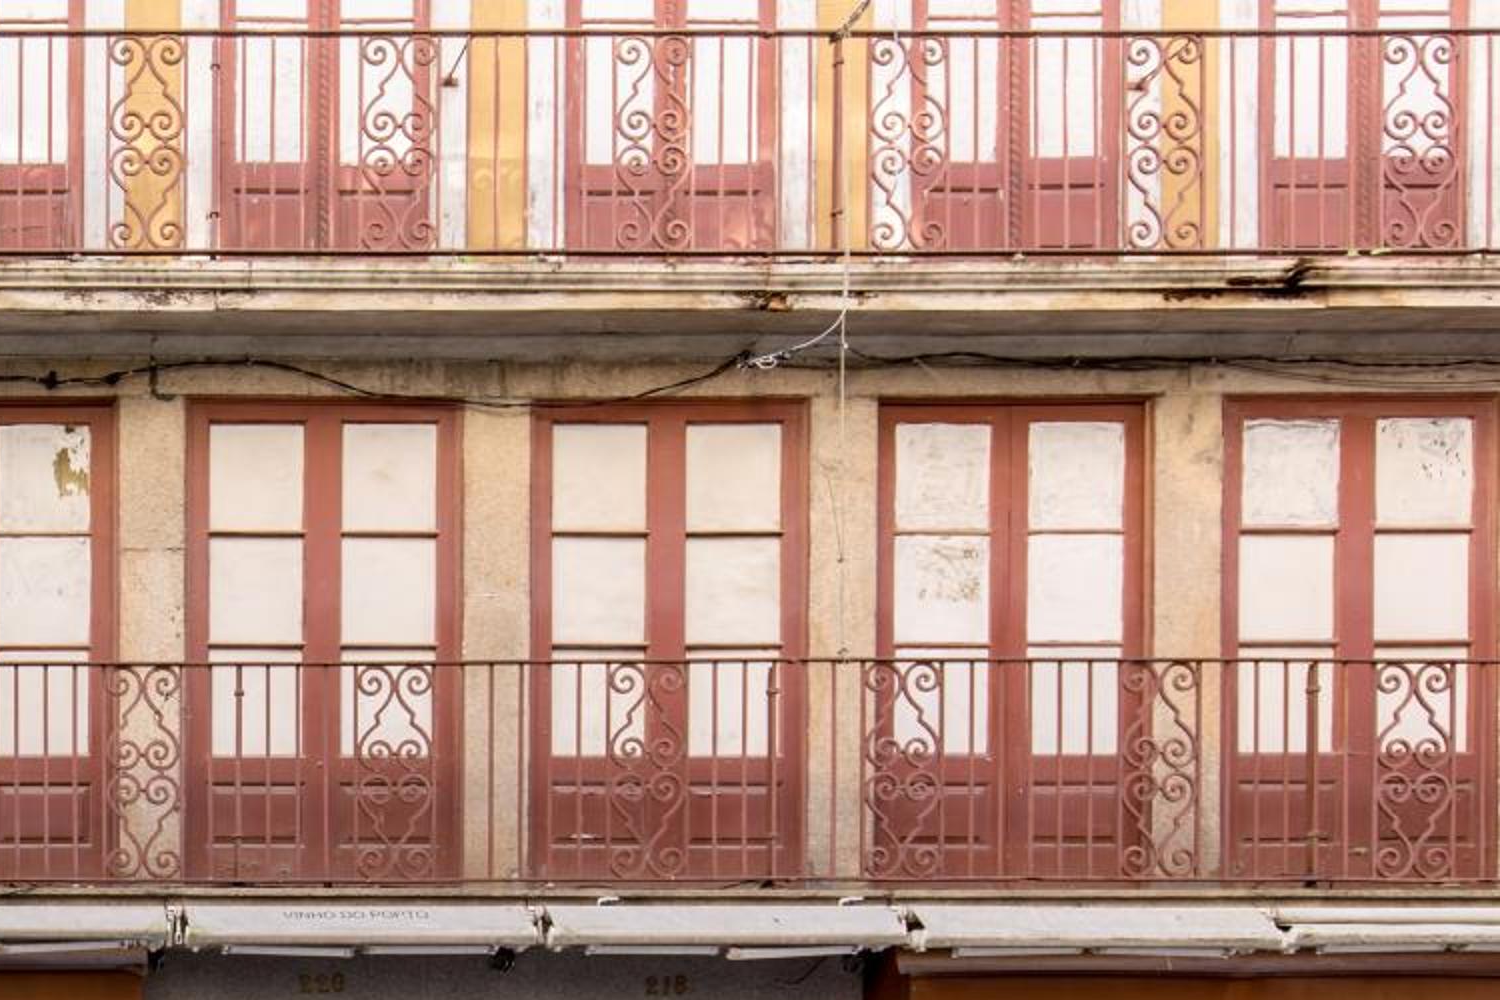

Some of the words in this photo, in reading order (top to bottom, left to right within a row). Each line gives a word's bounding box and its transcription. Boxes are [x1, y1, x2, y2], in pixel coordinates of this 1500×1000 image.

[283, 911, 336, 919] VINHO
[339, 911, 365, 919] DO
[370, 911, 429, 919] PORTO
[645, 974, 687, 995] 218
